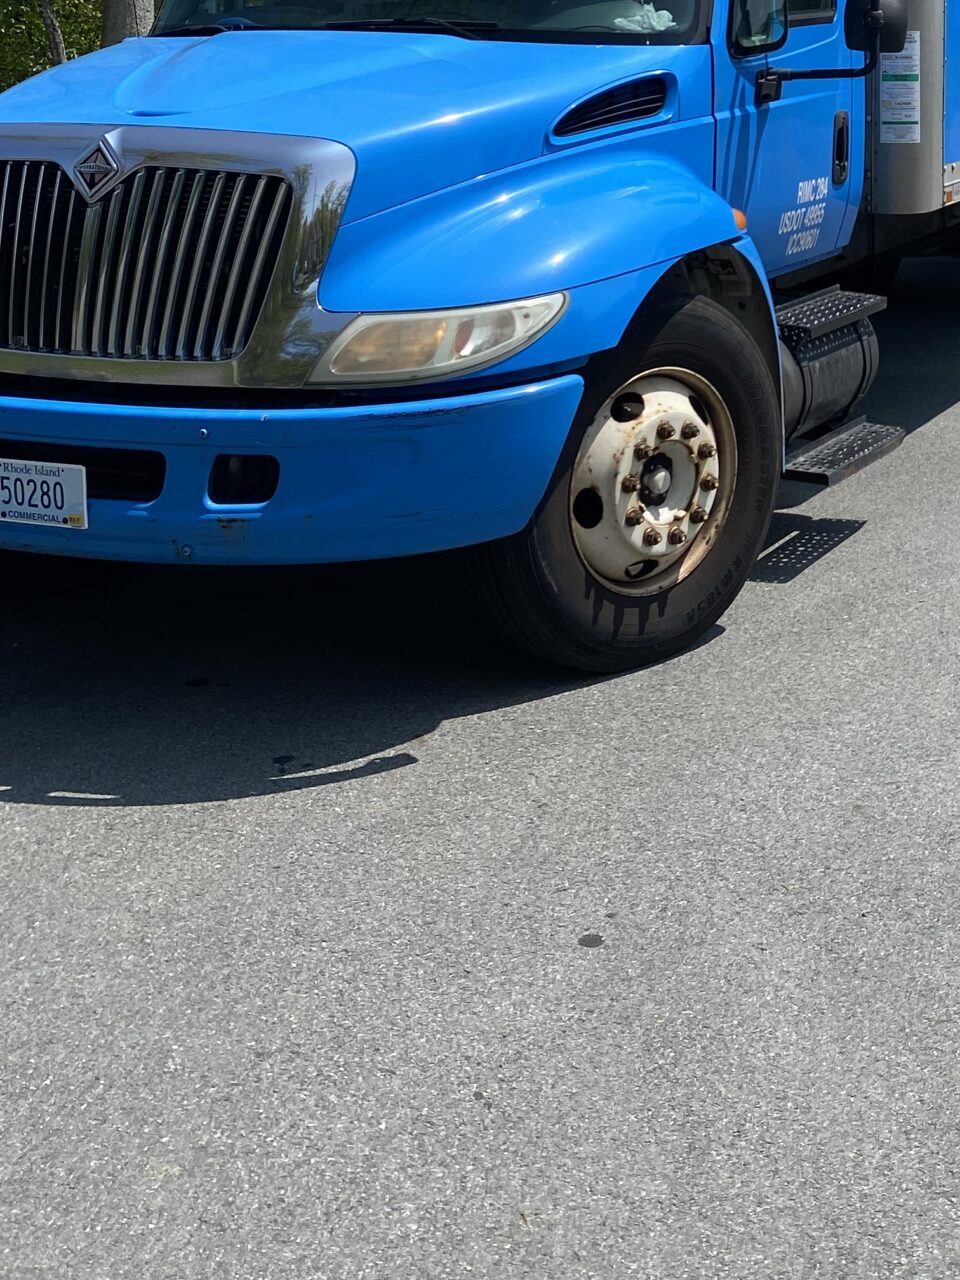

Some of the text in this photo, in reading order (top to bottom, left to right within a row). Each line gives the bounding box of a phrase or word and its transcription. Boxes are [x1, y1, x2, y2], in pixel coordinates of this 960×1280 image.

[778, 207, 807, 235] USDOT
[3, 462, 60, 478] Rhode Island
[0, 476, 65, 511] 50280
[8, 510, 61, 523] COMMERCIAL
